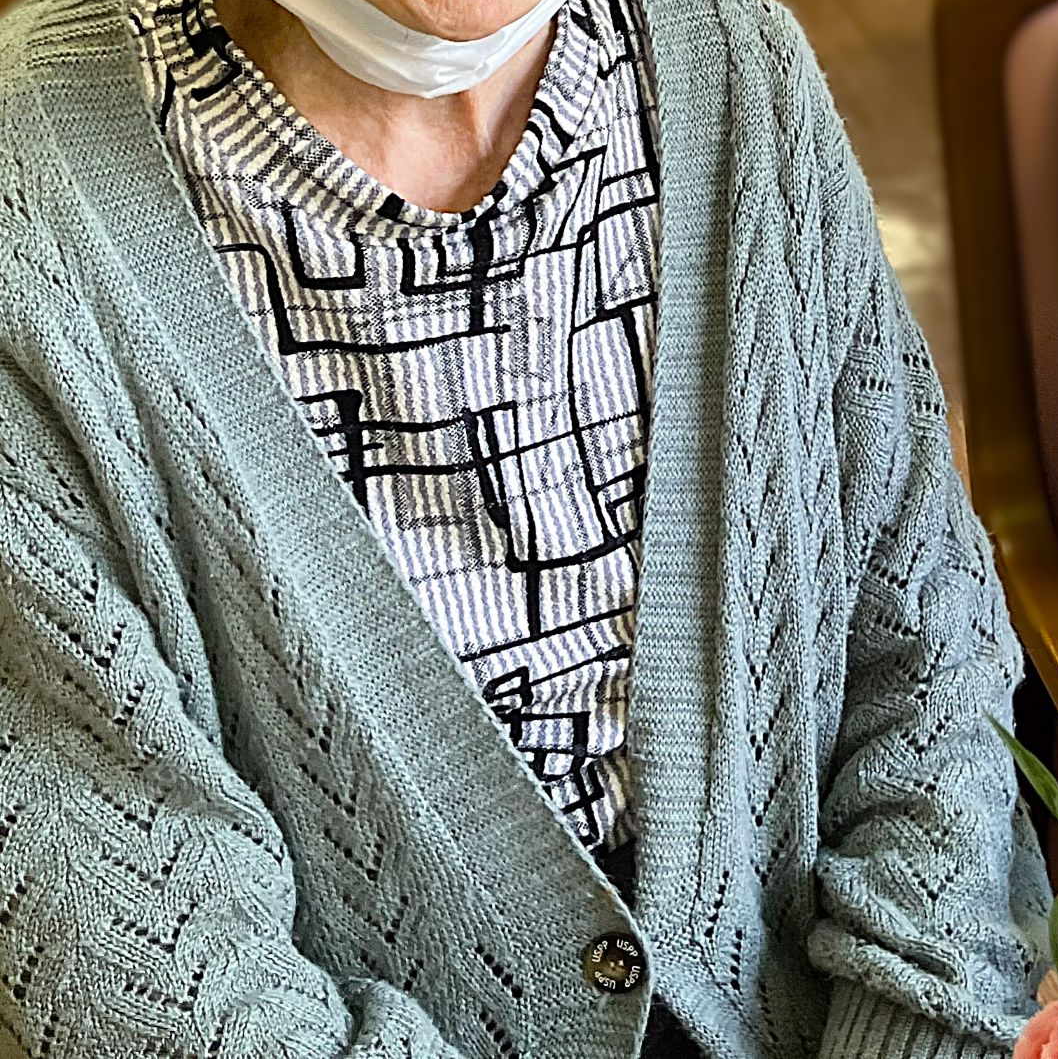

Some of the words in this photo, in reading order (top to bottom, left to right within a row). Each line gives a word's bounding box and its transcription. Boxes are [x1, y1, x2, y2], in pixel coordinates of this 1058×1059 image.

[592, 940, 608, 962] USPP
[616, 939, 638, 957] USPP
[594, 971, 616, 990] USPP
[624, 965, 641, 988] USPP
